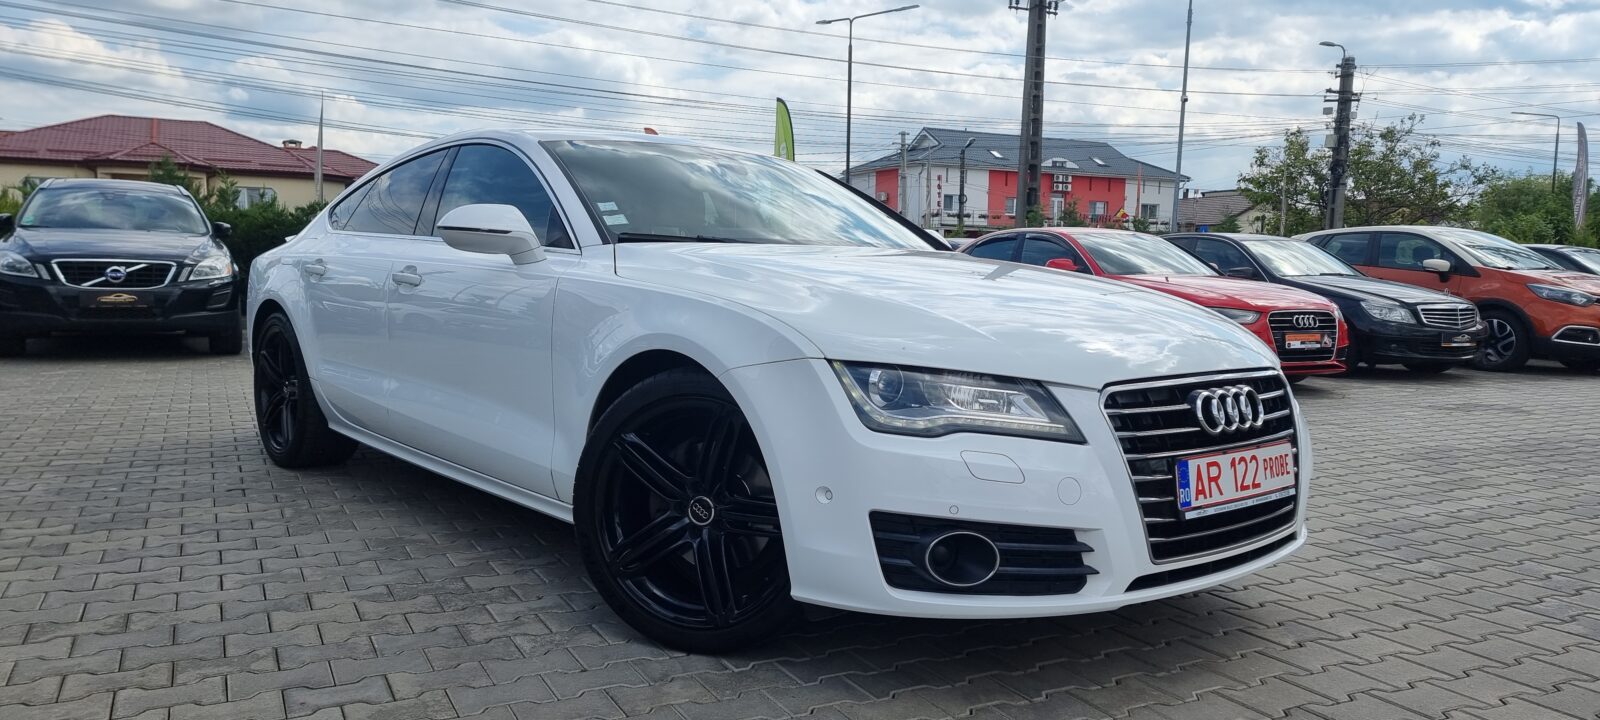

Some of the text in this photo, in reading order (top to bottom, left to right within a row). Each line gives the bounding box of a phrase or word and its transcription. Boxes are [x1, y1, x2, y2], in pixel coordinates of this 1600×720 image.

[1195, 454, 1290, 501] AR 122 PROBE
[1180, 488, 1191, 503] RO
